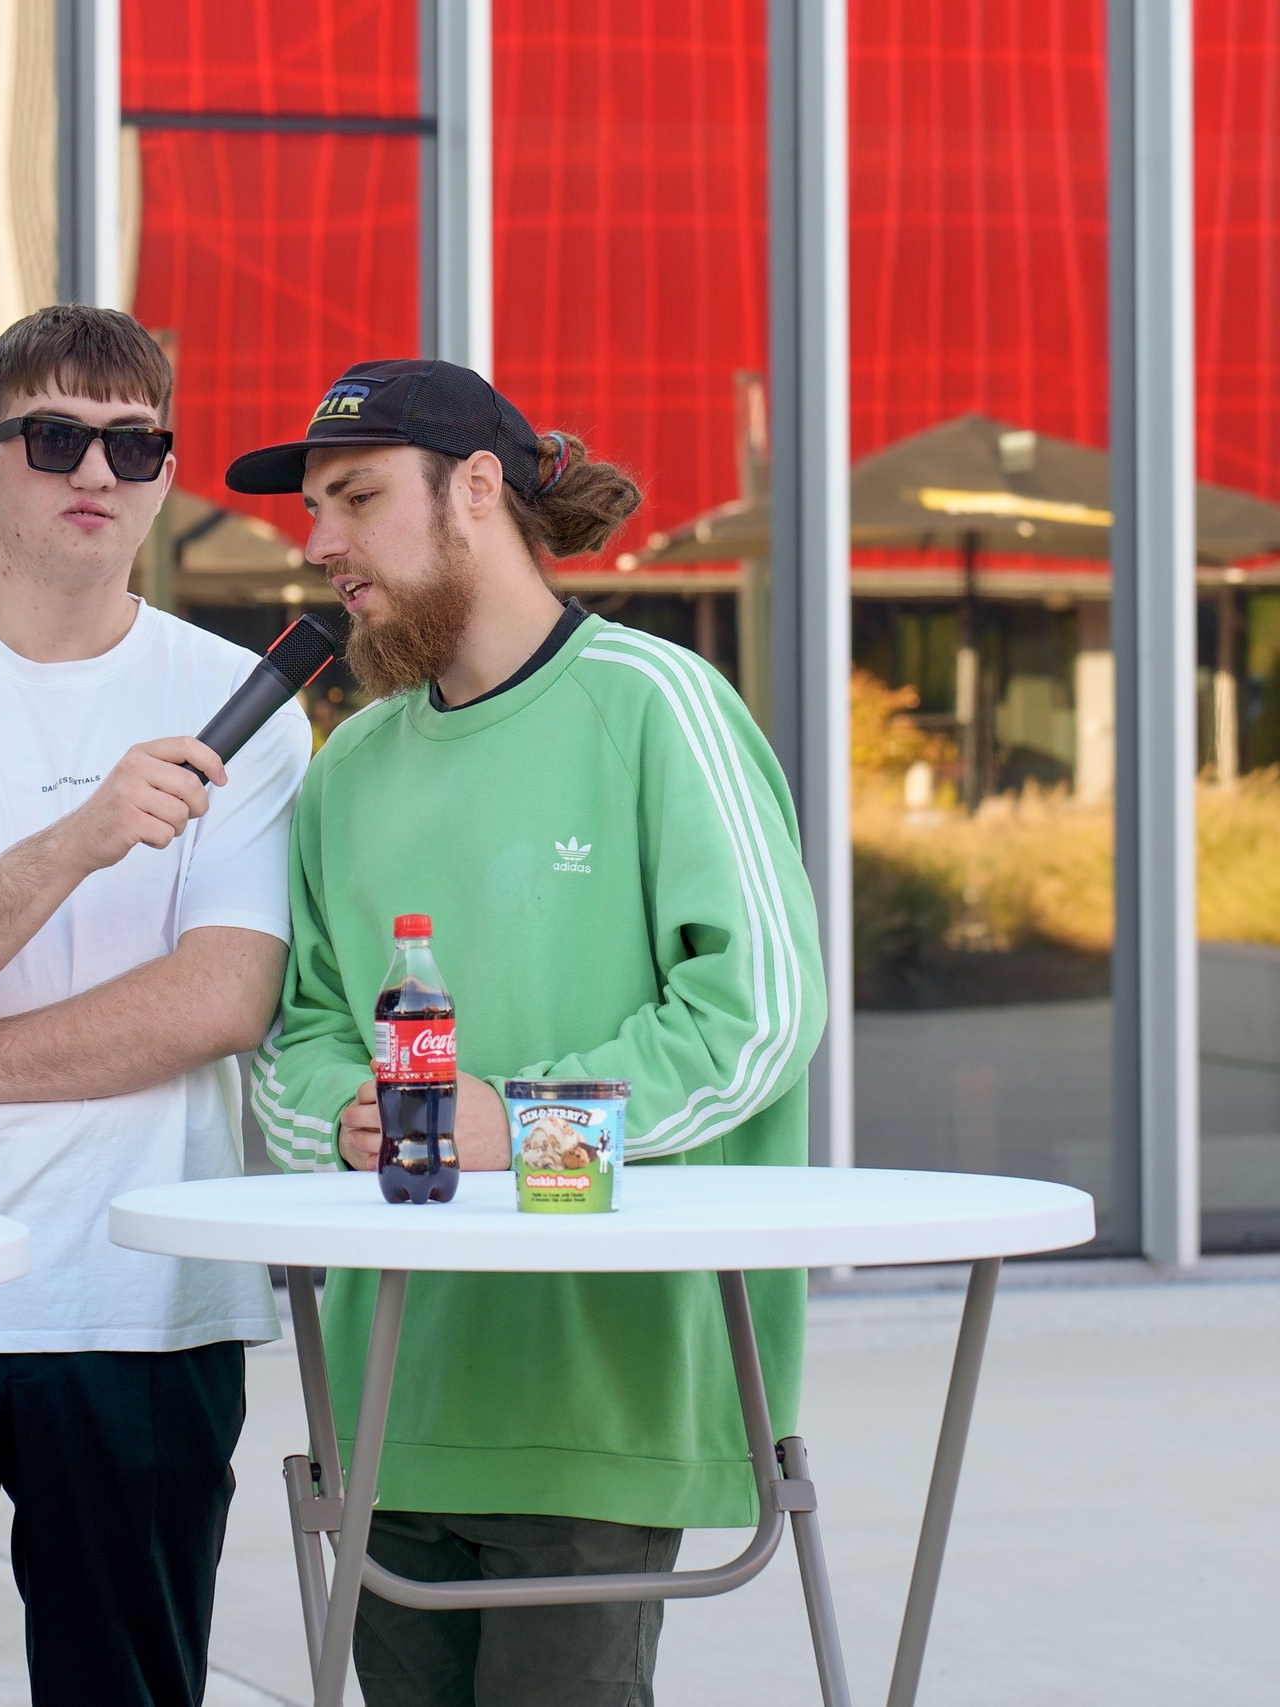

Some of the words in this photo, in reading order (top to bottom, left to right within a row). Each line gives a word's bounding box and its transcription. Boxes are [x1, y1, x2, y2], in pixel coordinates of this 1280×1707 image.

[552, 862, 591, 874] adidas
[390, 1024, 396, 1037] ME
[526, 1175, 556, 1187] Cookie
[556, 1175, 590, 1190] Dough
